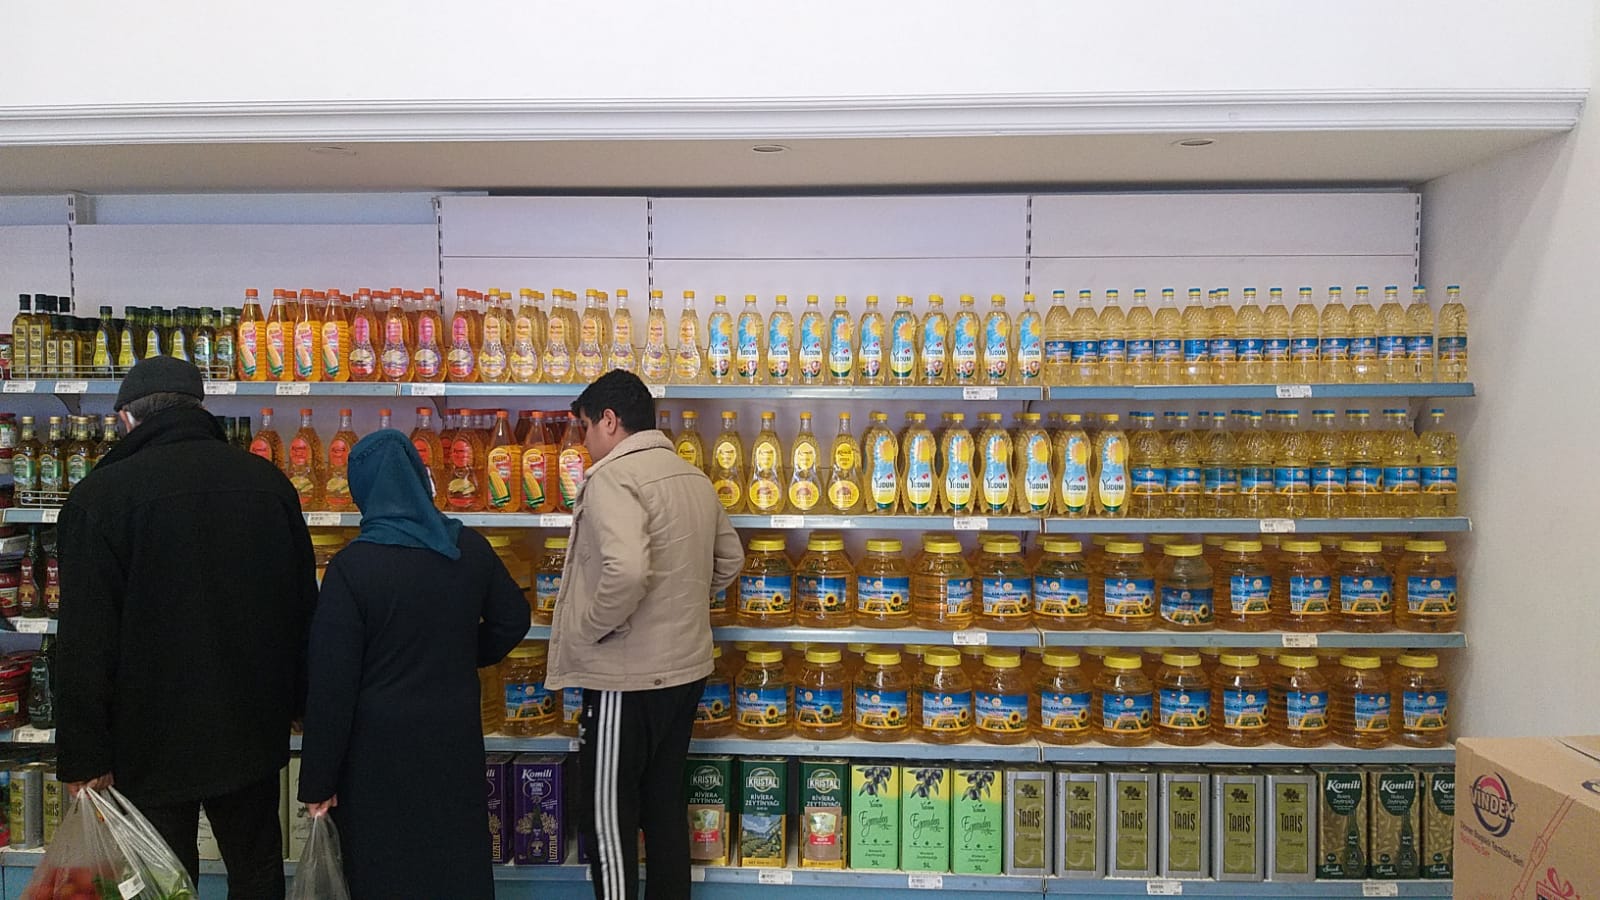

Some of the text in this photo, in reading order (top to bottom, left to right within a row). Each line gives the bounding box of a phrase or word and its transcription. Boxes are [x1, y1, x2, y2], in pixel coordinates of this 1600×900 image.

[1028, 477, 1048, 489] YUDUM
[1065, 479, 1086, 491] YUDUM
[1102, 479, 1124, 491] YUDUM
[522, 768, 553, 782] Komili
[1326, 780, 1360, 794] Komili
[1380, 780, 1414, 794] Komili
